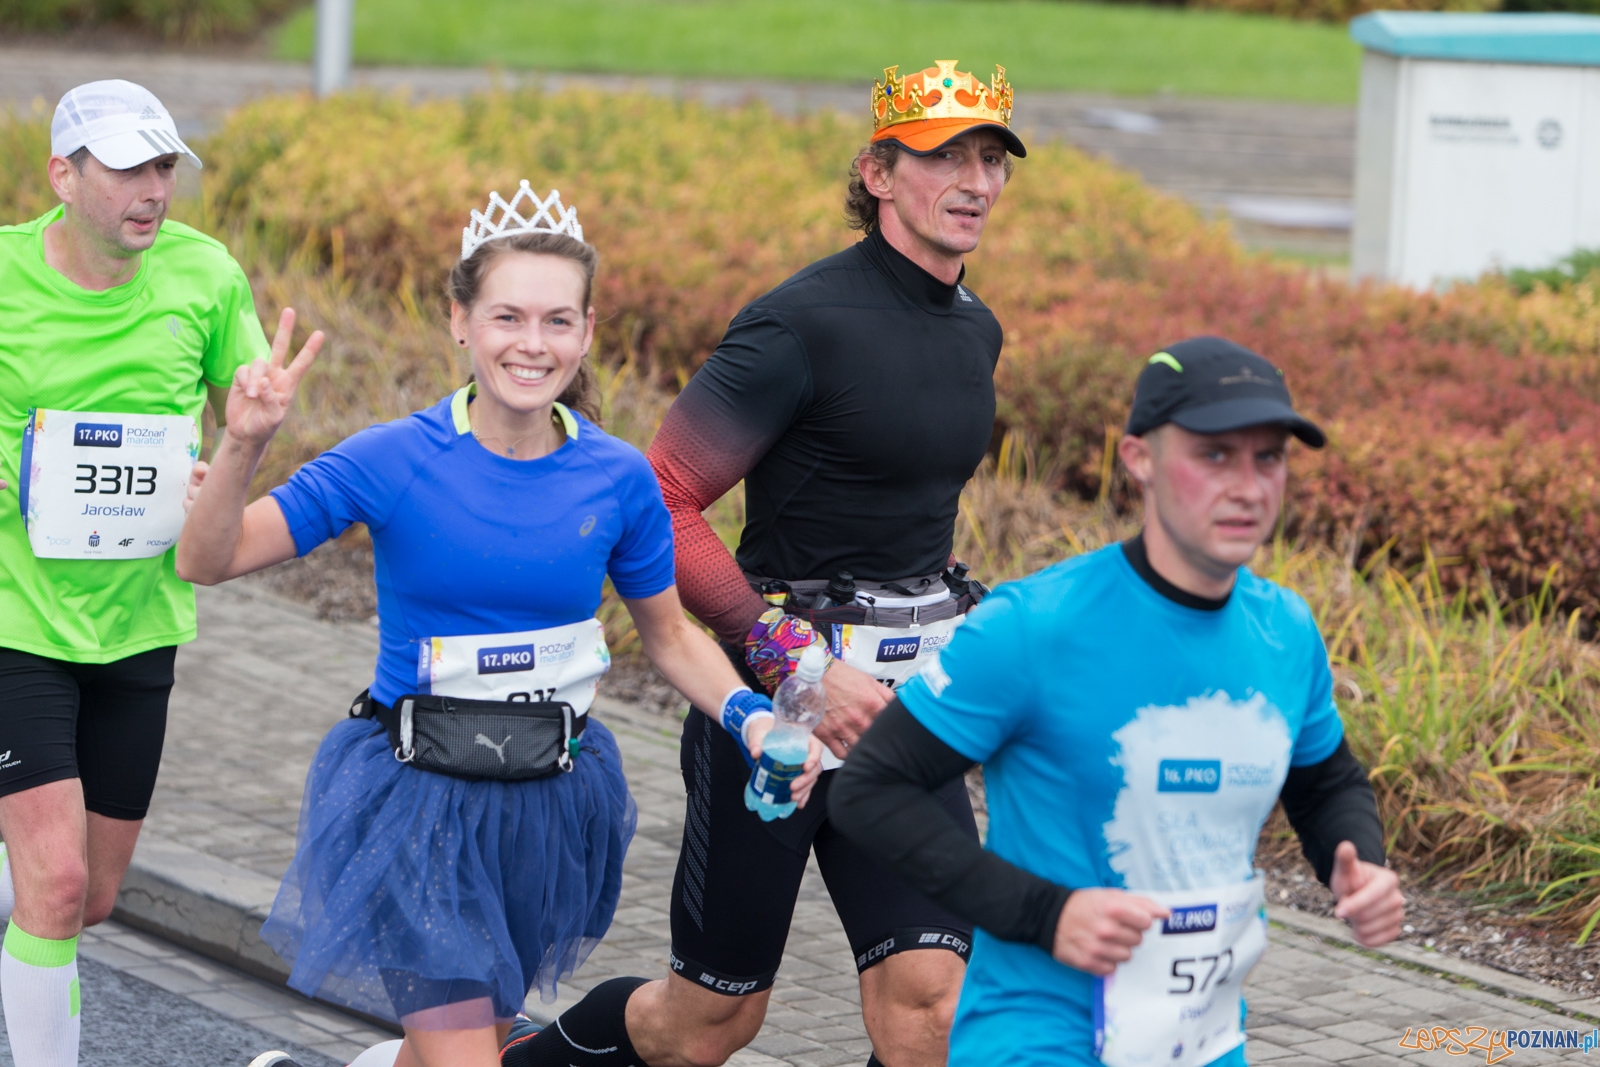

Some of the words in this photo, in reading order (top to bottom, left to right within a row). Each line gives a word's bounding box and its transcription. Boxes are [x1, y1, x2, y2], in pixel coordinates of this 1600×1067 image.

[126, 437, 165, 445] maraton
[74, 463, 158, 496] 3313
[81, 503, 146, 517] Jarosław
[920, 645, 941, 654] mara
[539, 650, 575, 664] maraton
[2, 760, 21, 769] TOUCH
[868, 938, 895, 956] cep
[941, 934, 969, 953] cep
[670, 952, 685, 970] ep
[715, 979, 758, 994] cep
